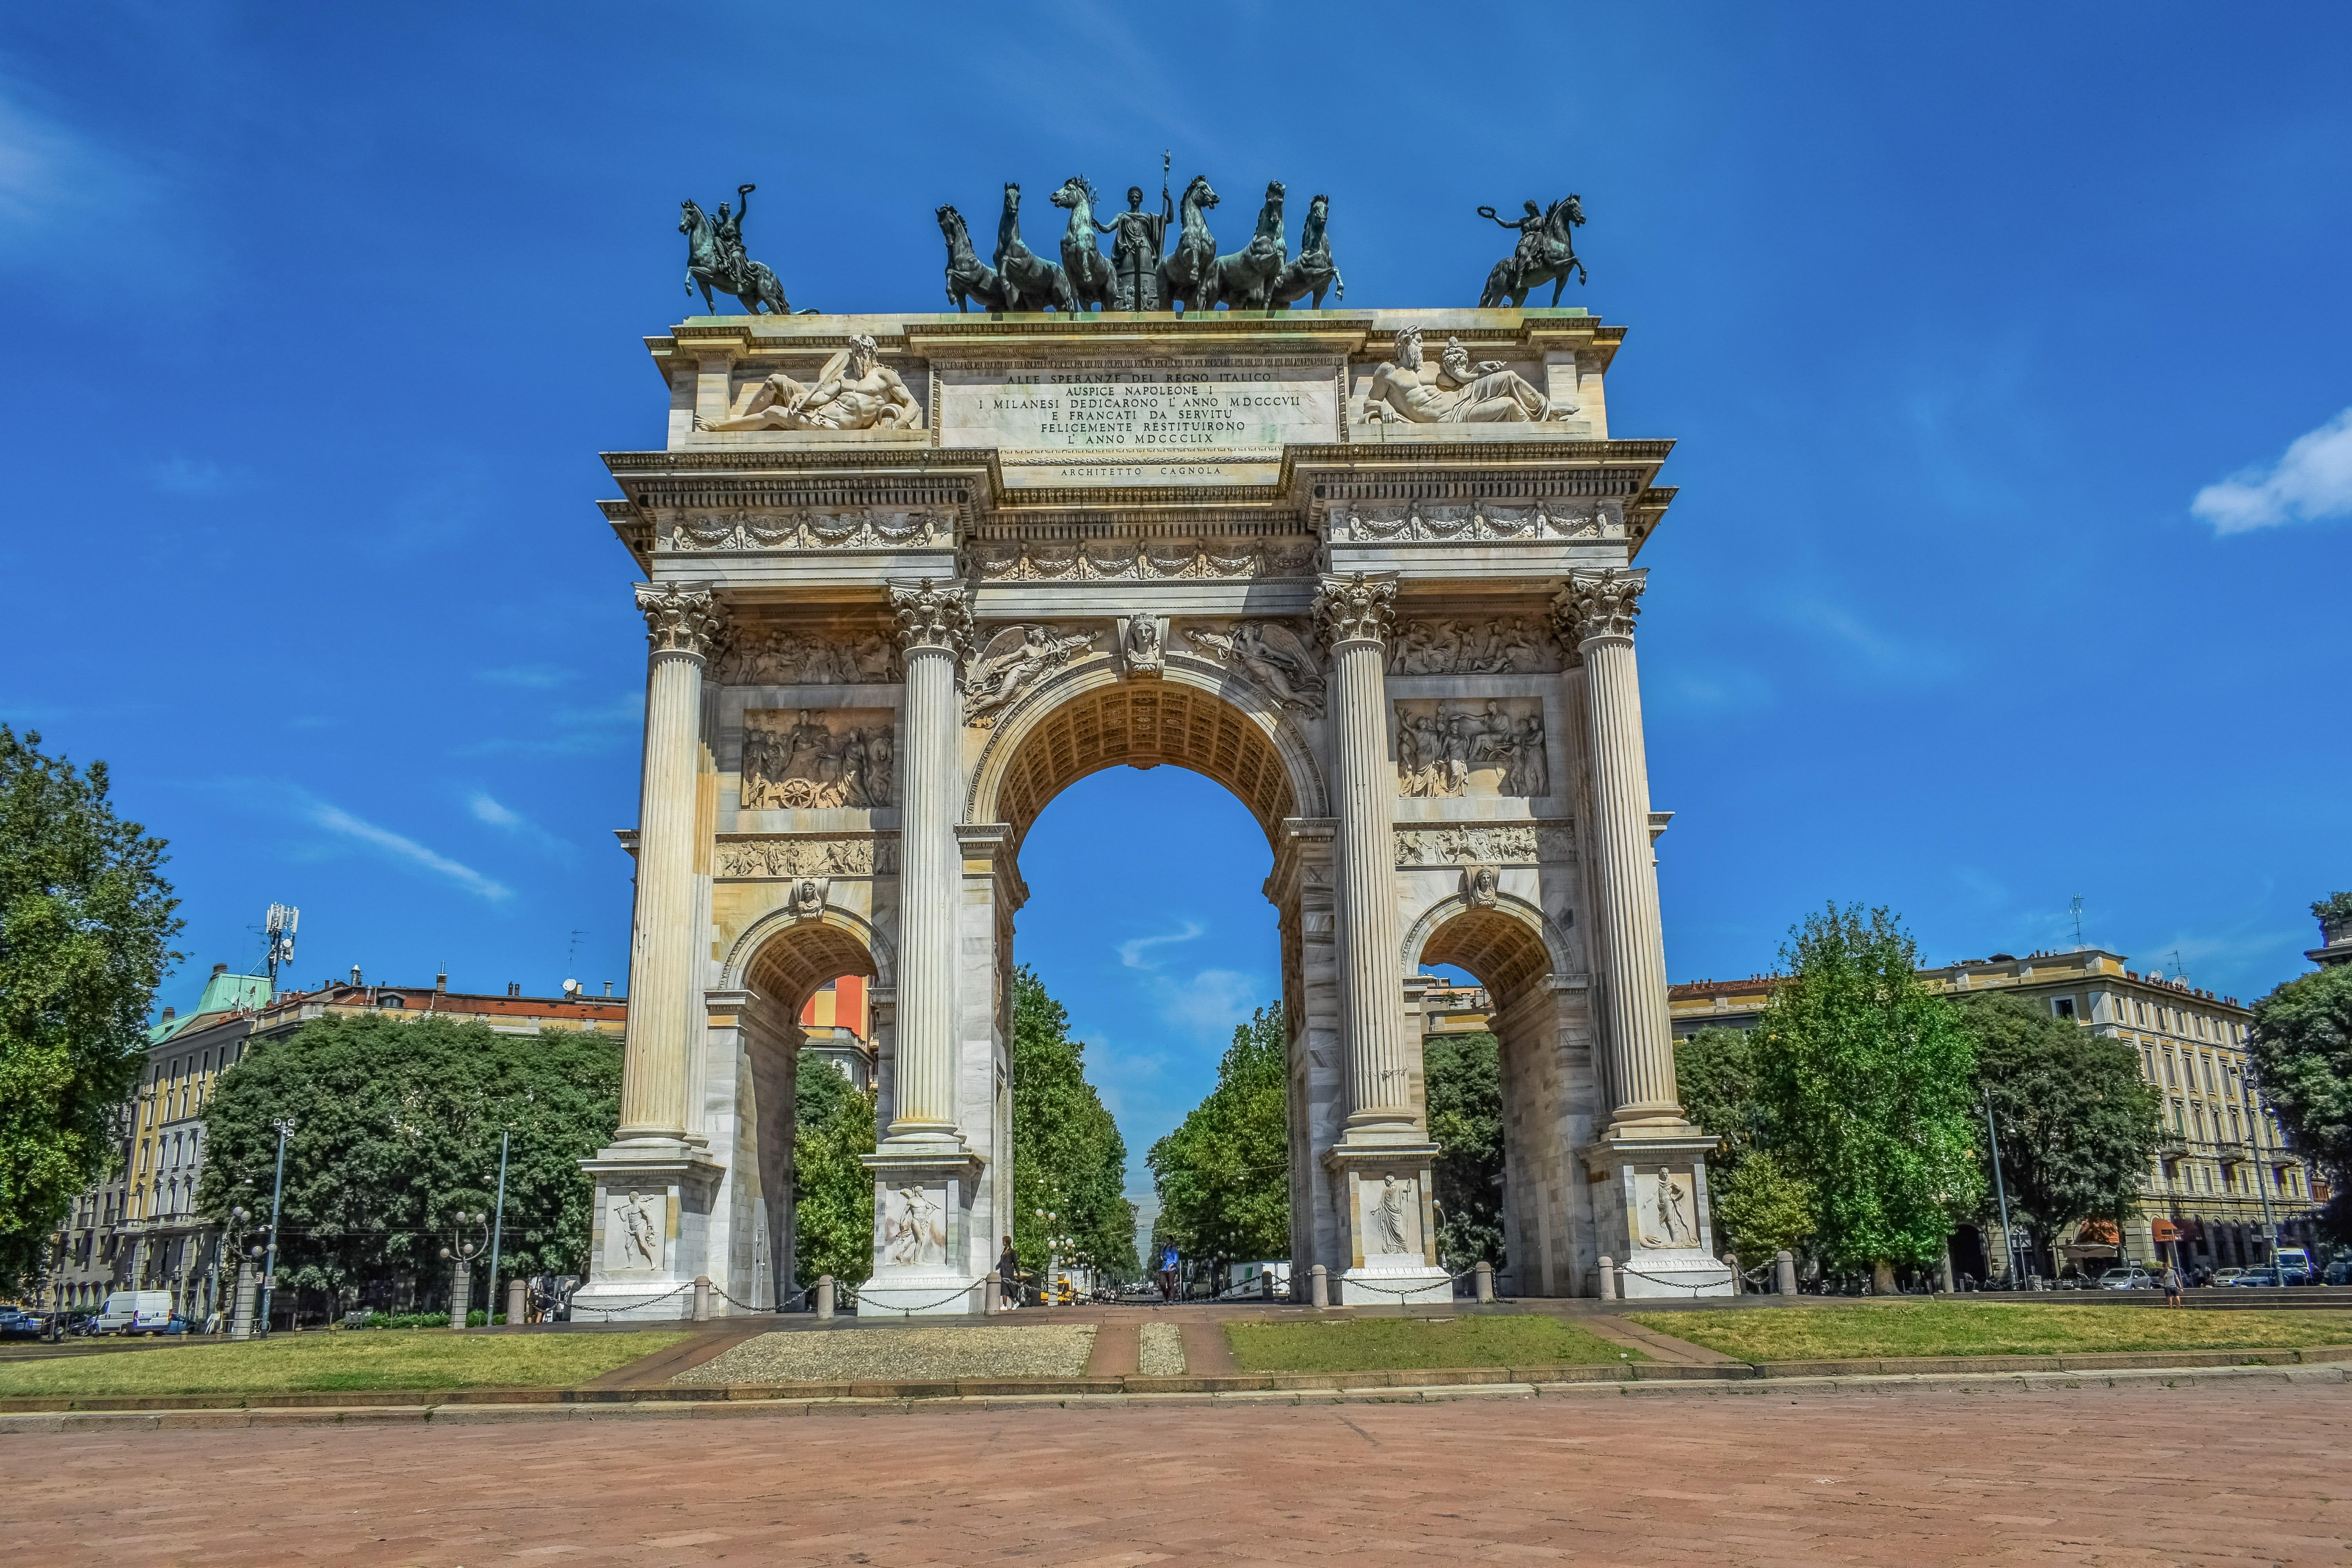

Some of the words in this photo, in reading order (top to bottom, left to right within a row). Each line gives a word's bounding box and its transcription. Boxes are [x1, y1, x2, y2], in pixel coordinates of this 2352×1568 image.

[1007, 376, 1040, 384] ALLE
[1051, 375, 1121, 384] SPERANZE
[1132, 374, 1156, 383] DEL
[1167, 374, 1209, 382] REGNO
[1220, 373, 1271, 381] ITALICO
[1066, 387, 1114, 396] AUSPICE
[1125, 386, 1198, 396] NAPOLEONE
[1209, 386, 1212, 395] I
[979, 400, 983, 409] I
[994, 399, 1059, 409] MILANESI
[1071, 399, 1158, 408] DEDICARONO
[1183, 398, 1218, 407] ANNO
[1230, 397, 1300, 406] MDCCCVII
[1052, 412, 1058, 420] E
[1070, 411, 1136, 420] FRANCATI
[1150, 411, 1167, 419] DA
[1179, 410, 1232, 419] SERVITU
[1041, 423, 1132, 432] FELICEMENTE
[1143, 422, 1245, 431] RESTITUIRONO
[1086, 435, 1125, 443] ANNO
[1135, 434, 1213, 443] MDCCCLIX
